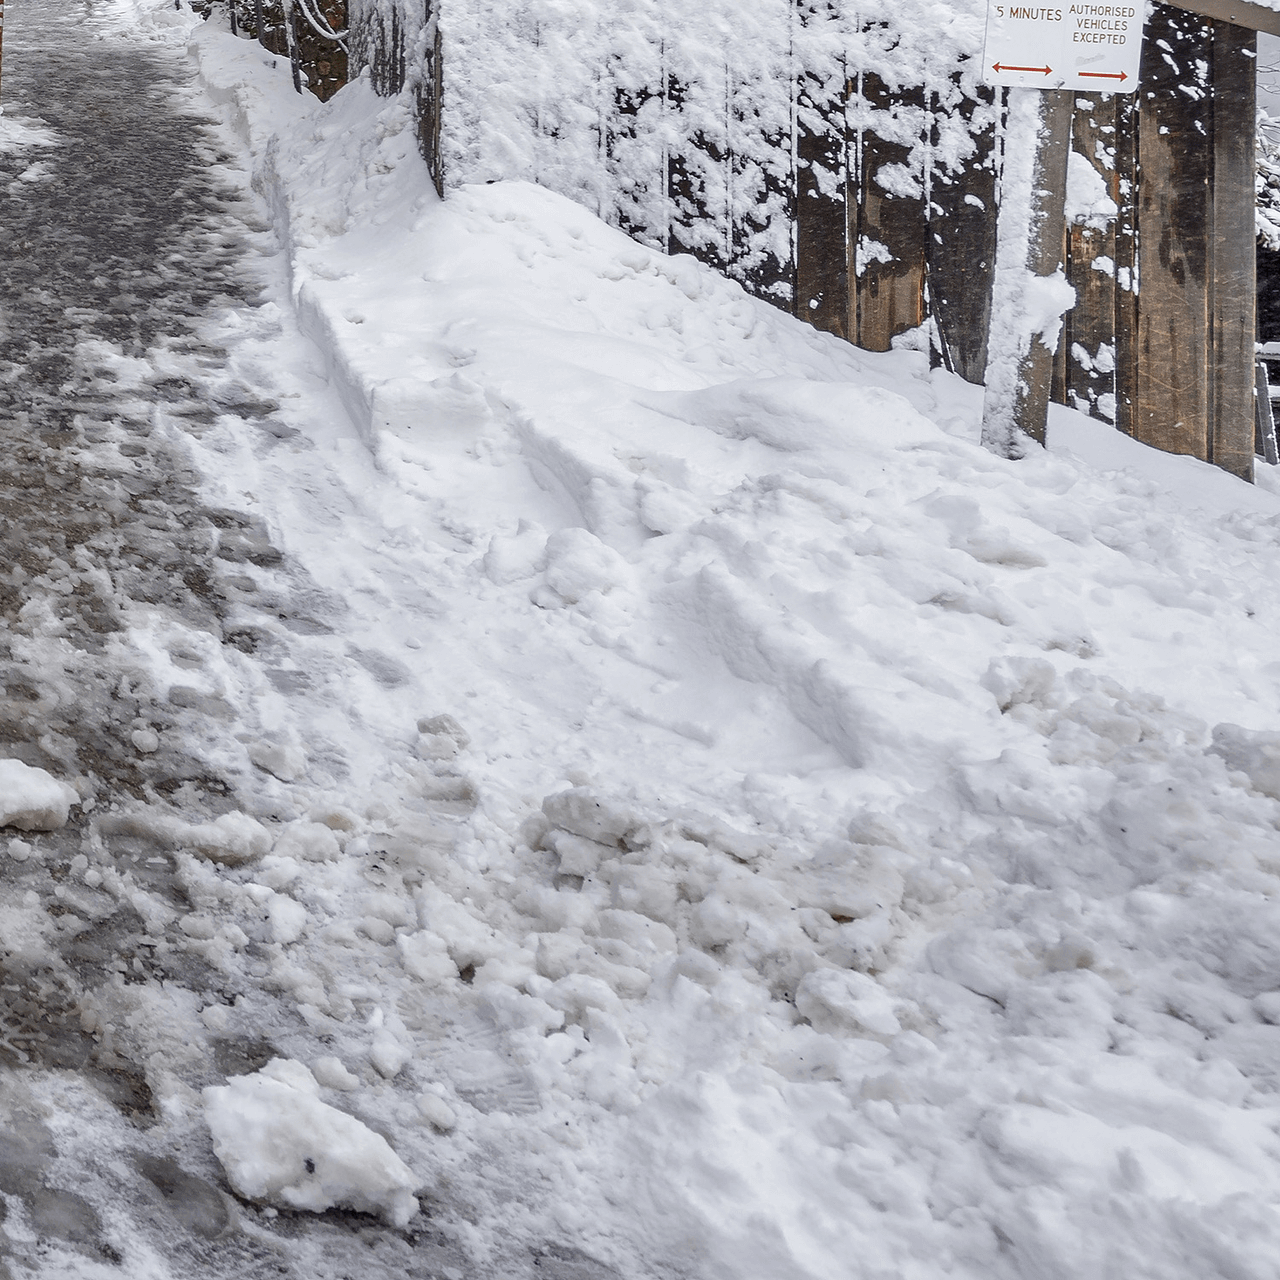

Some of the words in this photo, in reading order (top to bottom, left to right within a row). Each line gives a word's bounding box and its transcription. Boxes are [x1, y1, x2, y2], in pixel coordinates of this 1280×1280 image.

[1009, 6, 1063, 22] MINUTES
[1068, 4, 1136, 18] AUTHORISED
[1076, 18, 1129, 31] VEHICLES
[1072, 31, 1127, 45] EXCEPTED
